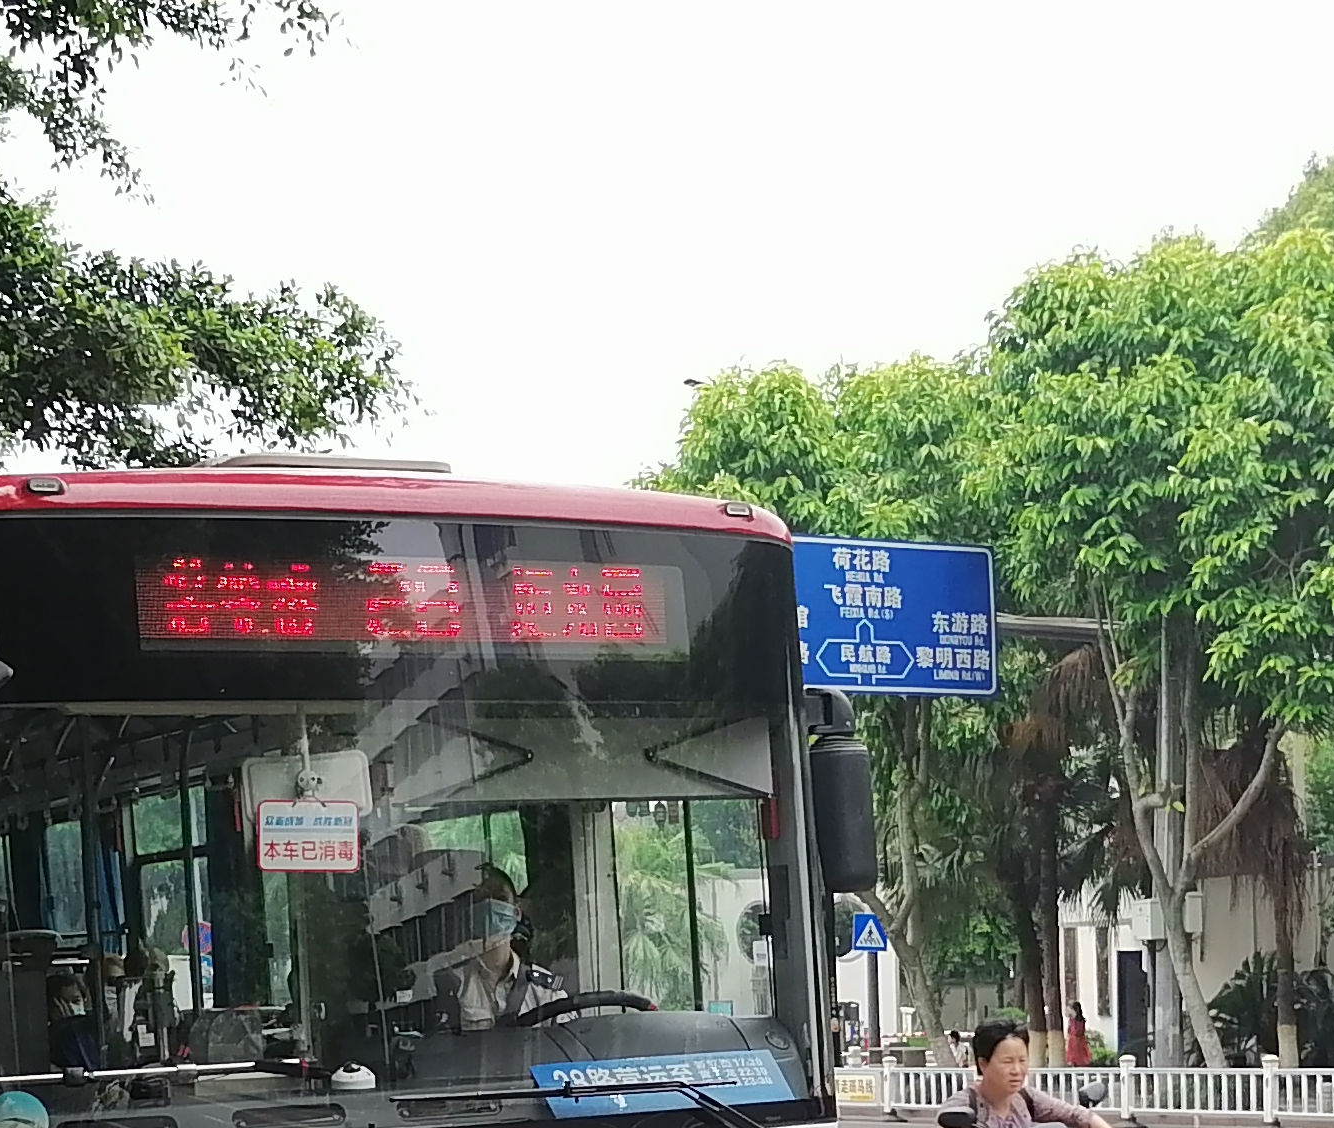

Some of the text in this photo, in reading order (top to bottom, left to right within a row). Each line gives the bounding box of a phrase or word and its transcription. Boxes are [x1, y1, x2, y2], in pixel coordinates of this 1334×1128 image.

[832, 547, 890, 572] 荷花路
[824, 583, 902, 609] 飞霞南路
[931, 611, 988, 635] 东游路
[841, 644, 891, 664] 民航路
[916, 646, 990, 670] 黎明西路
[264, 840, 354, 861] 本车已消毒
